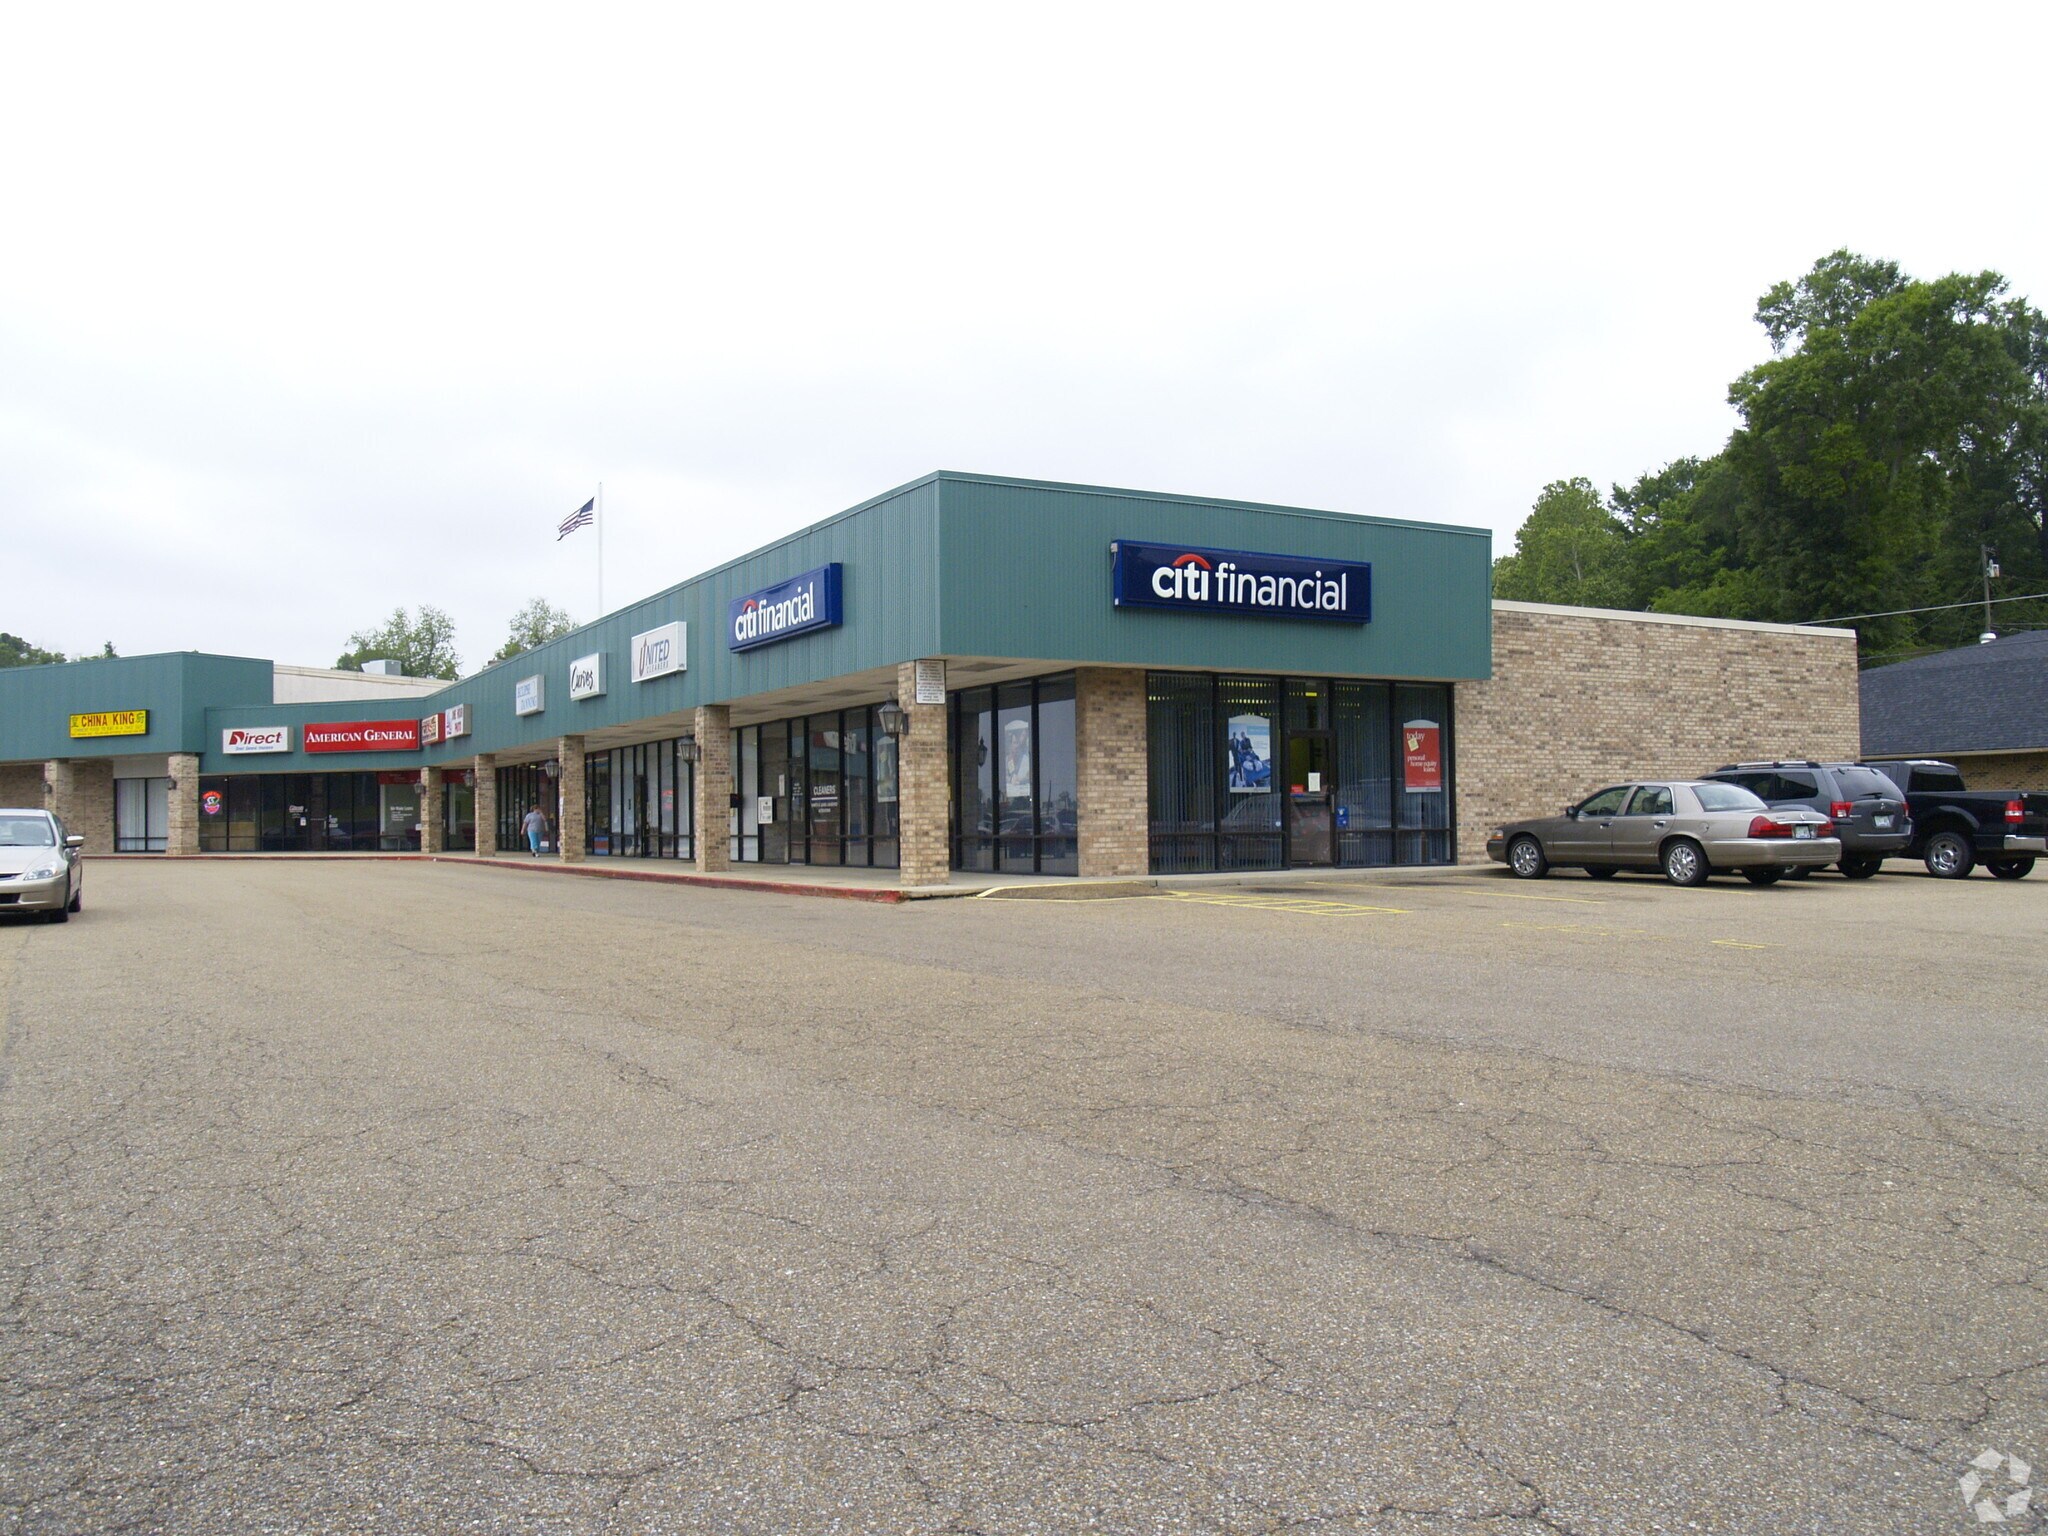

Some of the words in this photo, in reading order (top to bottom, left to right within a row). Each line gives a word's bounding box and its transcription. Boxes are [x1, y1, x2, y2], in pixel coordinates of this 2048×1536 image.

[639, 637, 670, 677] UNITED
[571, 665, 594, 692] Curves
[81, 714, 108, 728] CHINA
[113, 712, 135, 726] KING
[229, 730, 281, 745] Direct
[306, 731, 361, 743] AMERICAN
[364, 729, 414, 742] GENERAL
